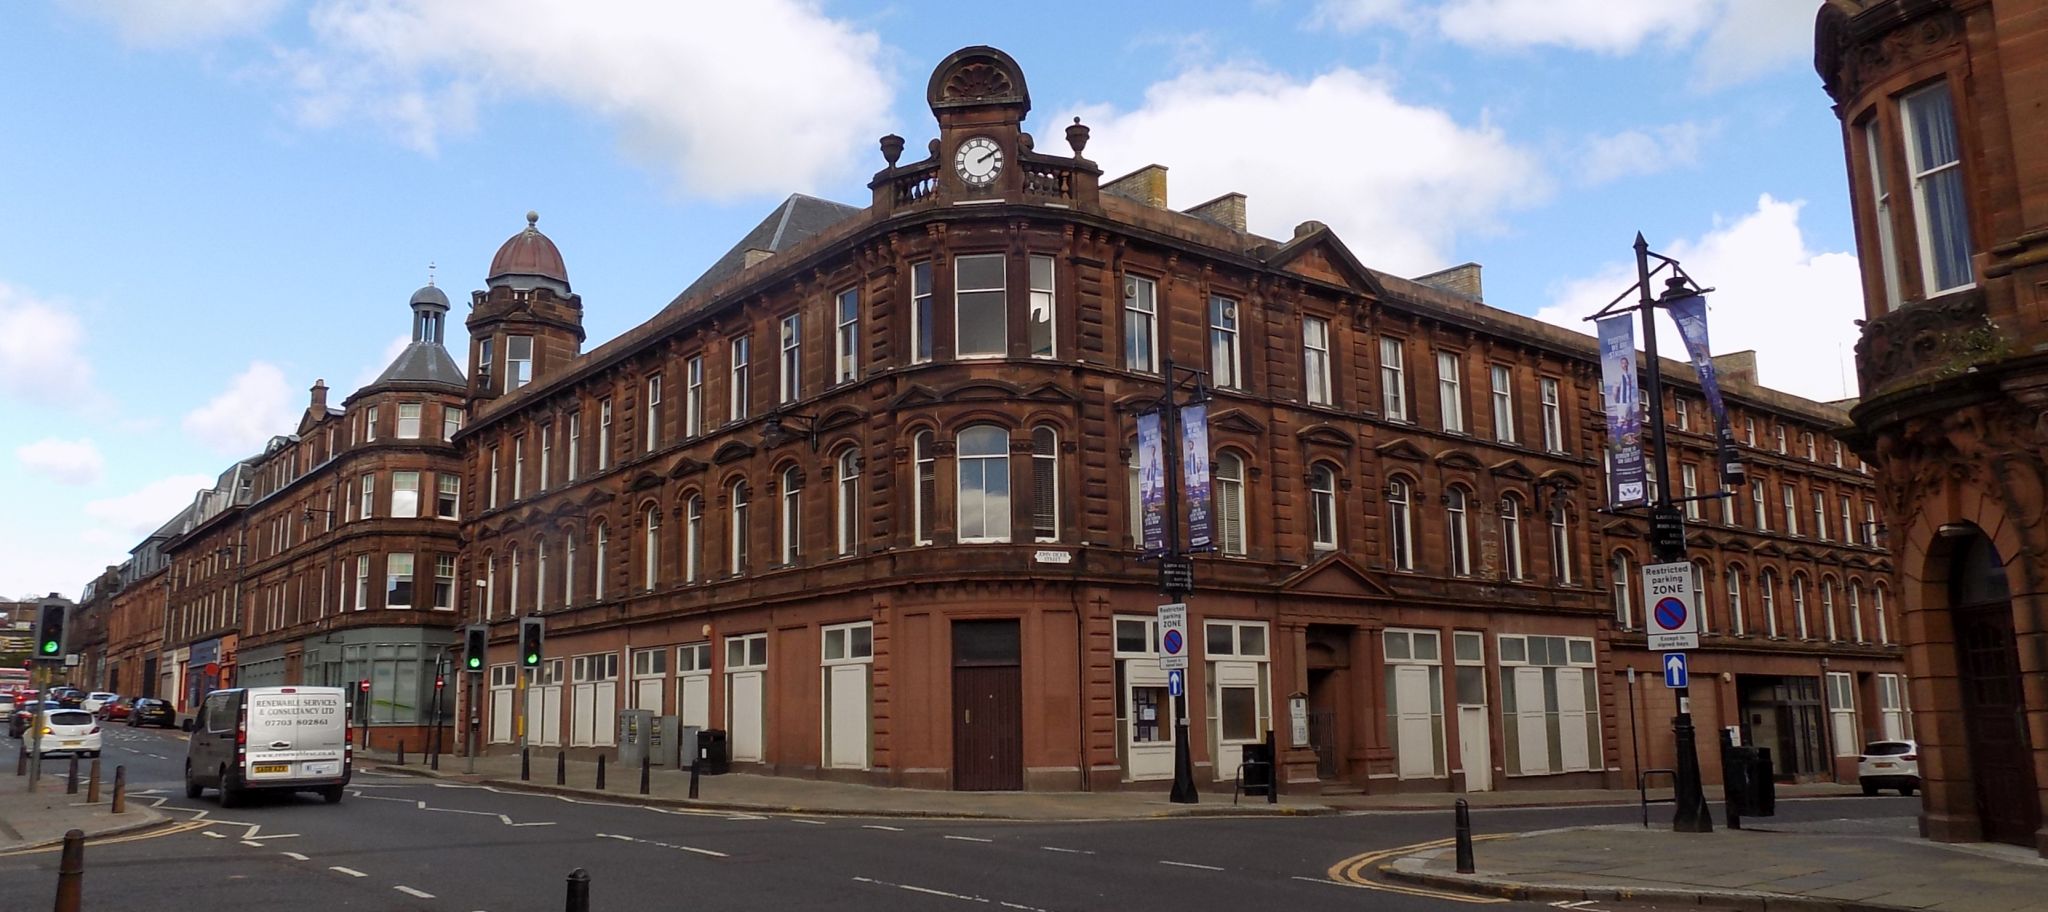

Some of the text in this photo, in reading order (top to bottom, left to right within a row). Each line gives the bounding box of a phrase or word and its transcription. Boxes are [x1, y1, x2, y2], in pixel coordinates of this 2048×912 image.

[1645, 565, 1689, 575] Restricted
[1651, 575, 1683, 584] parking
[1653, 584, 1684, 594] ZONE
[1163, 620, 1182, 628] ZONE
[256, 699, 300, 707] RENEWABLE
